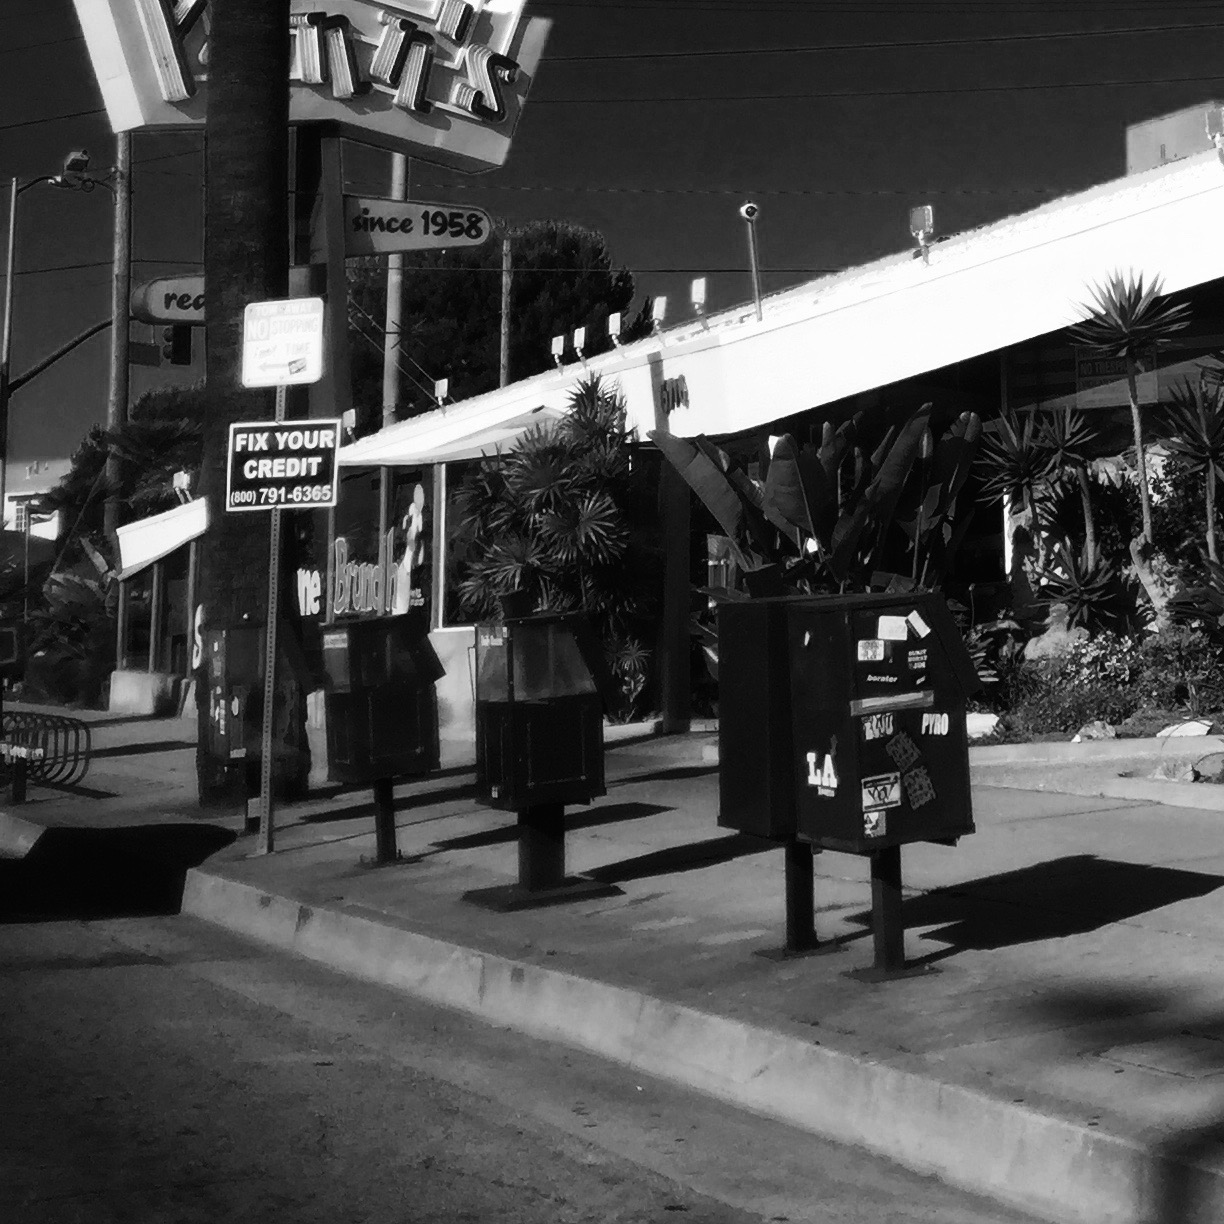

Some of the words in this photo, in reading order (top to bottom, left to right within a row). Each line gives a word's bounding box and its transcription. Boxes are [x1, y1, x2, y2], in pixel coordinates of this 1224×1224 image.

[352, 207, 414, 234] since
[421, 209, 484, 239] 1958
[247, 319, 268, 339] NO
[272, 317, 319, 336] STOPPING
[285, 342, 311, 355] TIME
[235, 432, 269, 452] FIX
[275, 429, 335, 450] YOUR
[243, 456, 322, 479] CREDIT
[230, 491, 257, 505] (800)
[259, 485, 332, 504] 791-6365
[921, 712, 949, 736] PYRO
[806, 752, 838, 788] LA
